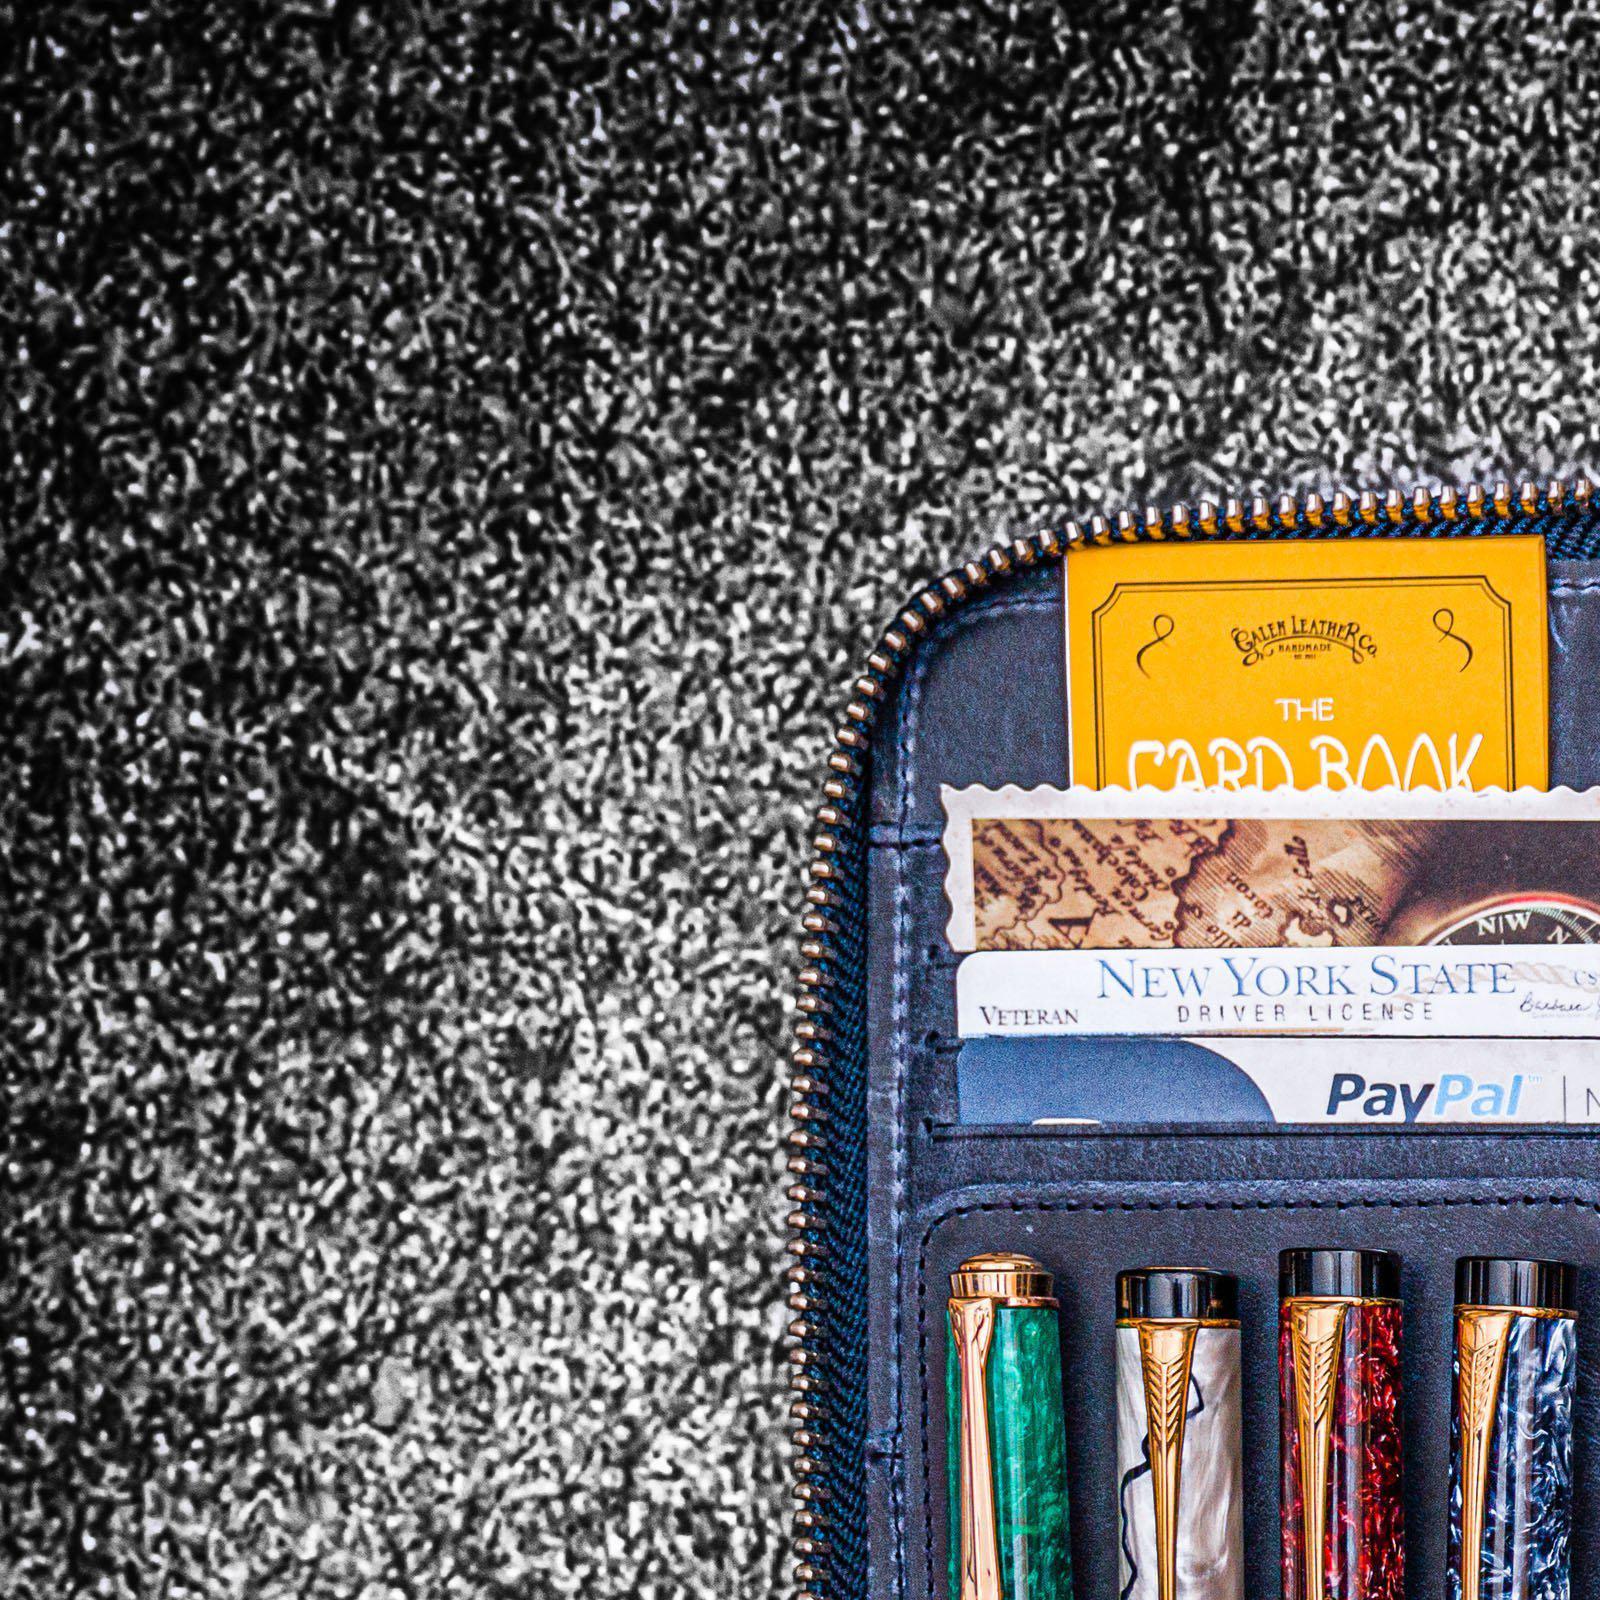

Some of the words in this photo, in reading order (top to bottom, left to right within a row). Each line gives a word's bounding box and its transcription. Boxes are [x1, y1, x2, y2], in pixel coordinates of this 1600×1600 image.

[1275, 697, 1334, 722] THE
[1127, 735, 1295, 791] CARD
[1309, 732, 1484, 792] BOOK
[979, 1005, 1080, 1026] VETERAN
[1177, 1003, 1286, 1024] DRIVER
[1307, 1002, 1434, 1022] LICENSE
[1325, 1072, 1525, 1123] PayPal
